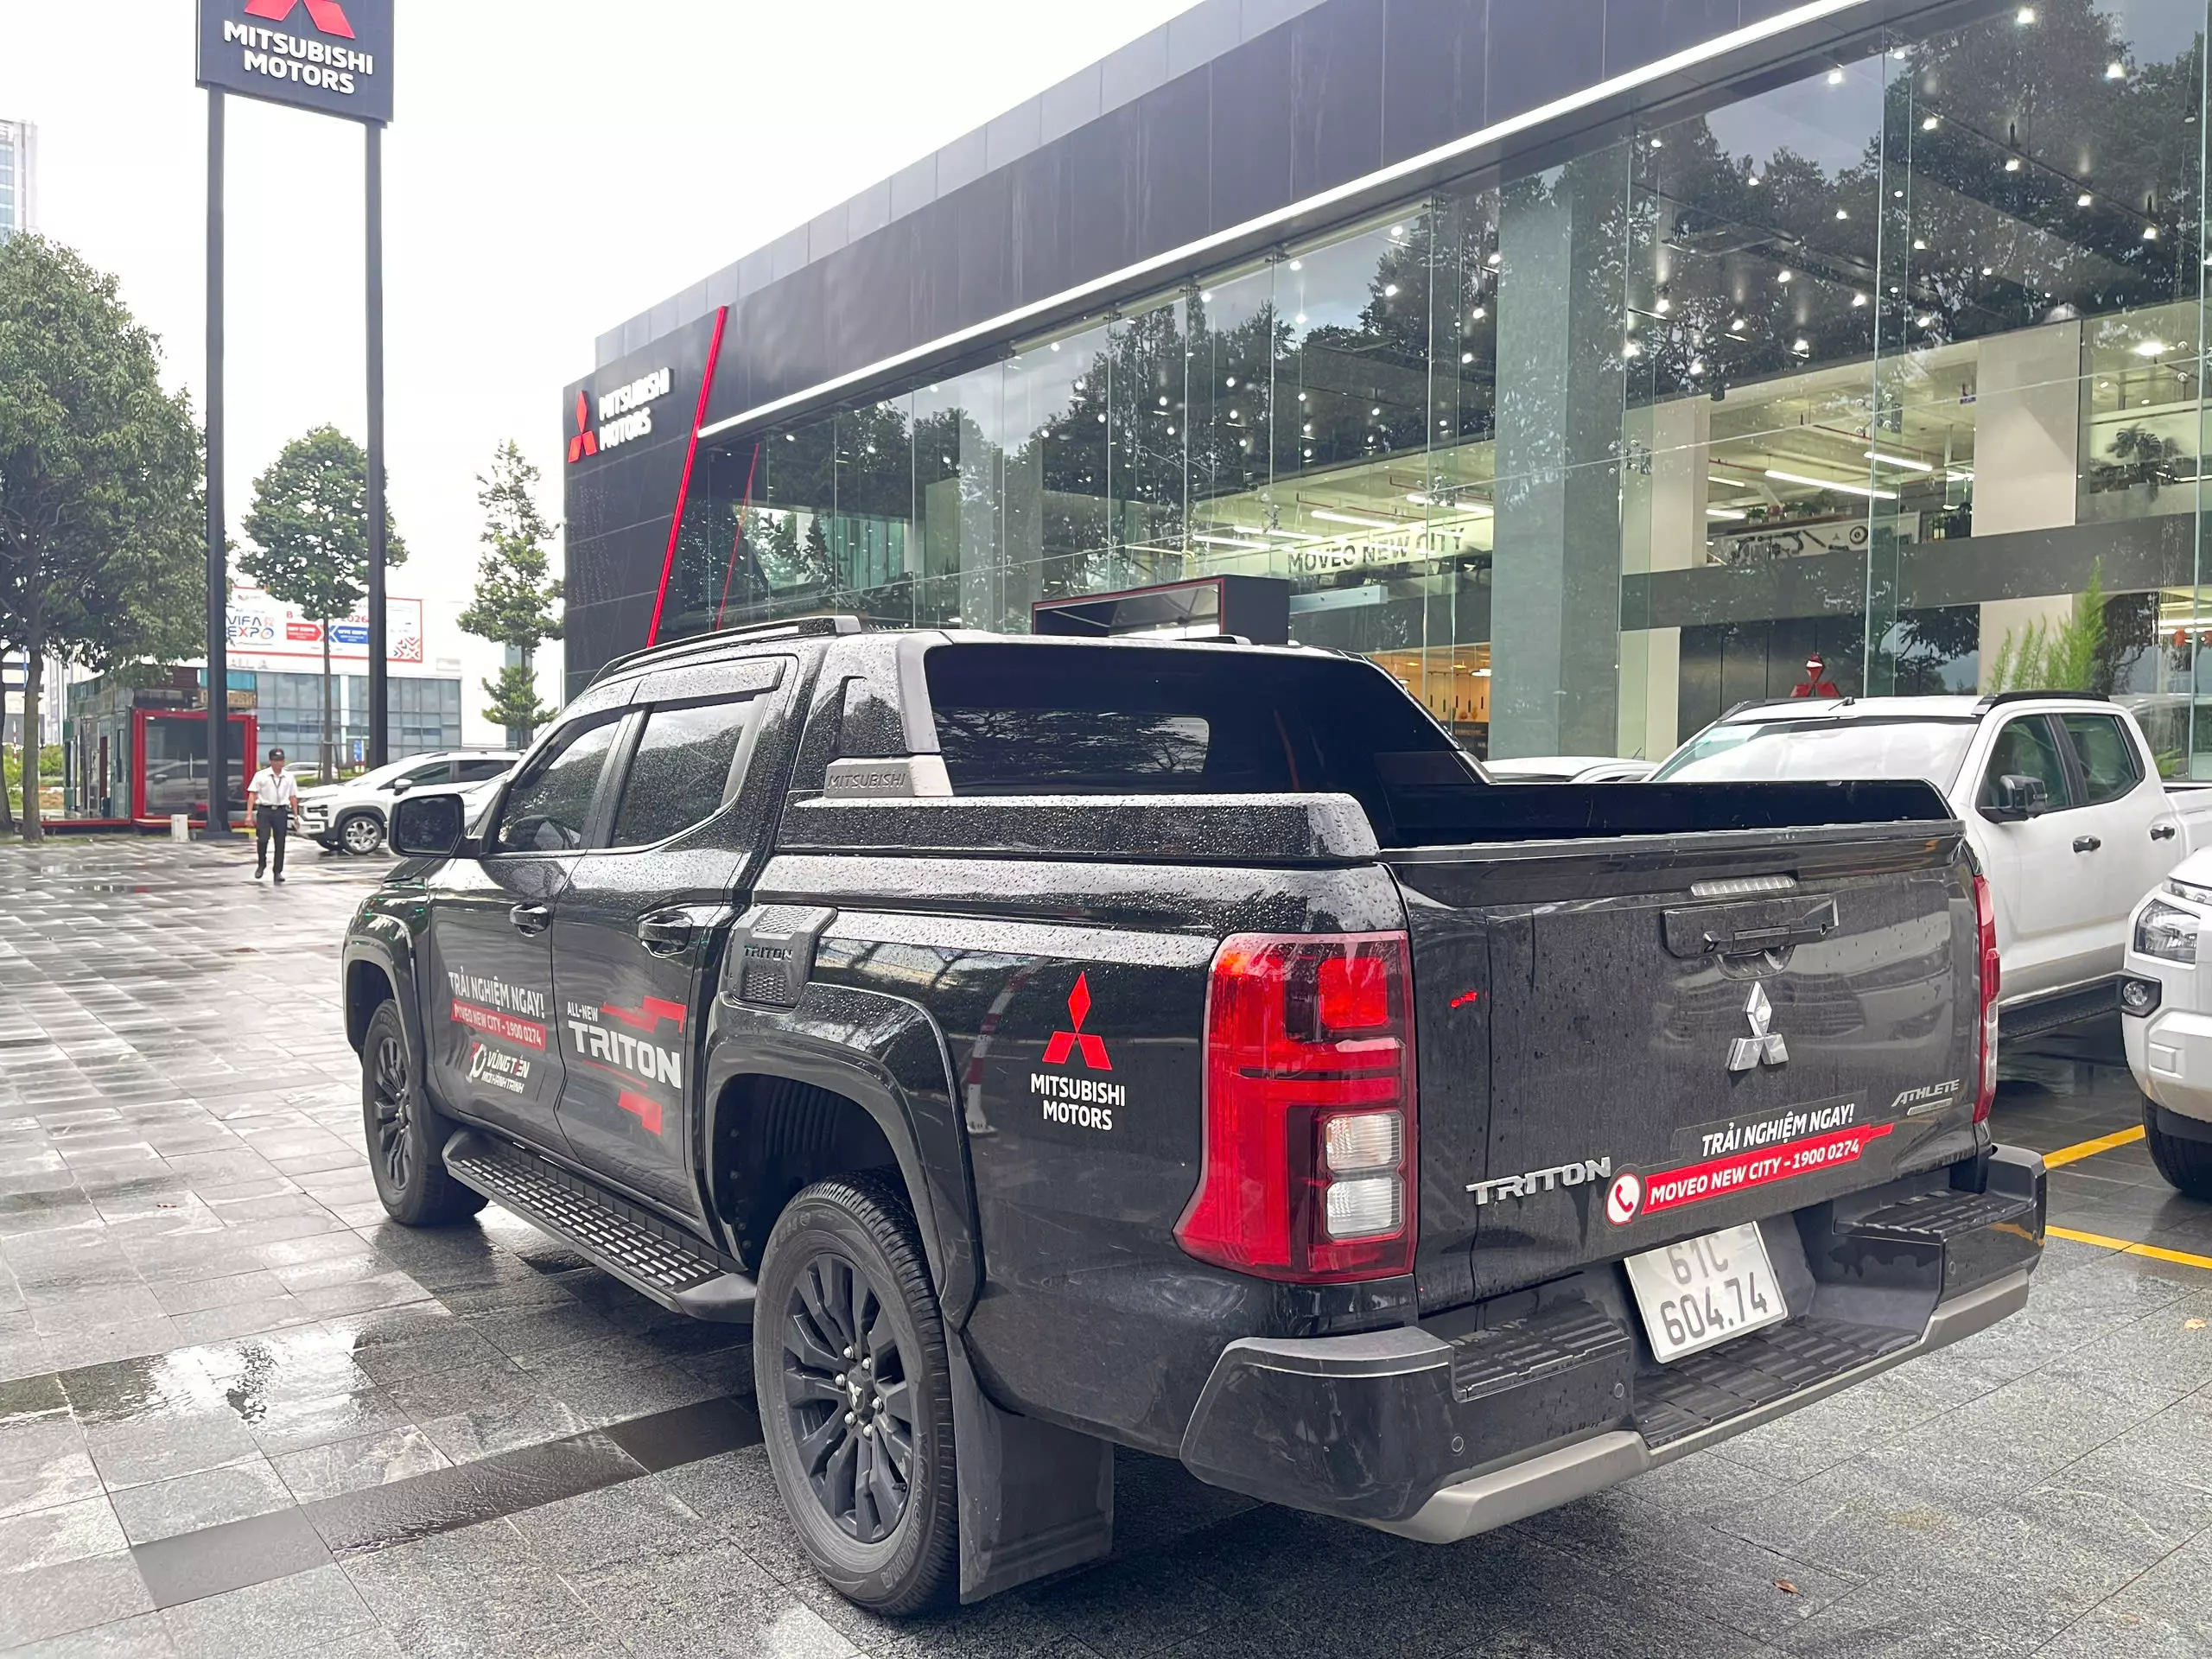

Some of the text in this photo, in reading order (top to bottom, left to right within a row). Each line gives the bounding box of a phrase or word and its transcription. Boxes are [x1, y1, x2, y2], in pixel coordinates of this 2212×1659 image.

[224, 20, 374, 75] MITSUBISHI
[244, 50, 355, 94] MOTORS
[599, 367, 671, 421] MITSUBISHI
[600, 406, 652, 451] MOTORS
[1288, 527, 1465, 574] MOVEO NEW CITY
[226, 615, 263, 626] VIFA
[227, 626, 275, 639] EXPO
[827, 772, 906, 790] MITSUBISHI
[744, 944, 793, 963] TRITON
[448, 965, 545, 1019] TRẢI NGHIỆM NGAY!
[567, 1001, 599, 1022] ALL-NEW
[487, 1014, 501, 1033] CITY
[505, 1020, 523, 1040] 1900
[524, 1026, 542, 1046] 0274
[568, 1020, 683, 1090] TRITON
[1030, 1072, 1126, 1107] MITSUBISHI
[1891, 1078, 1961, 1108] ATHLETE
[1043, 1099, 1113, 1131] MOTORS
[1702, 1103, 1855, 1157] TRẢI NGHIỆM NGAY!
[1465, 1156, 1611, 1205] TRITON
[1649, 1175, 1708, 1205] MOVEO
[1711, 1166, 1747, 1190] NEW
[1749, 1157, 1783, 1180] CITY
[1792, 1147, 1825, 1169] 1900
[1827, 1138, 1859, 1163] 0274
[1666, 1234, 1729, 1286] 61C
[1660, 1271, 1768, 1346] 604.74
